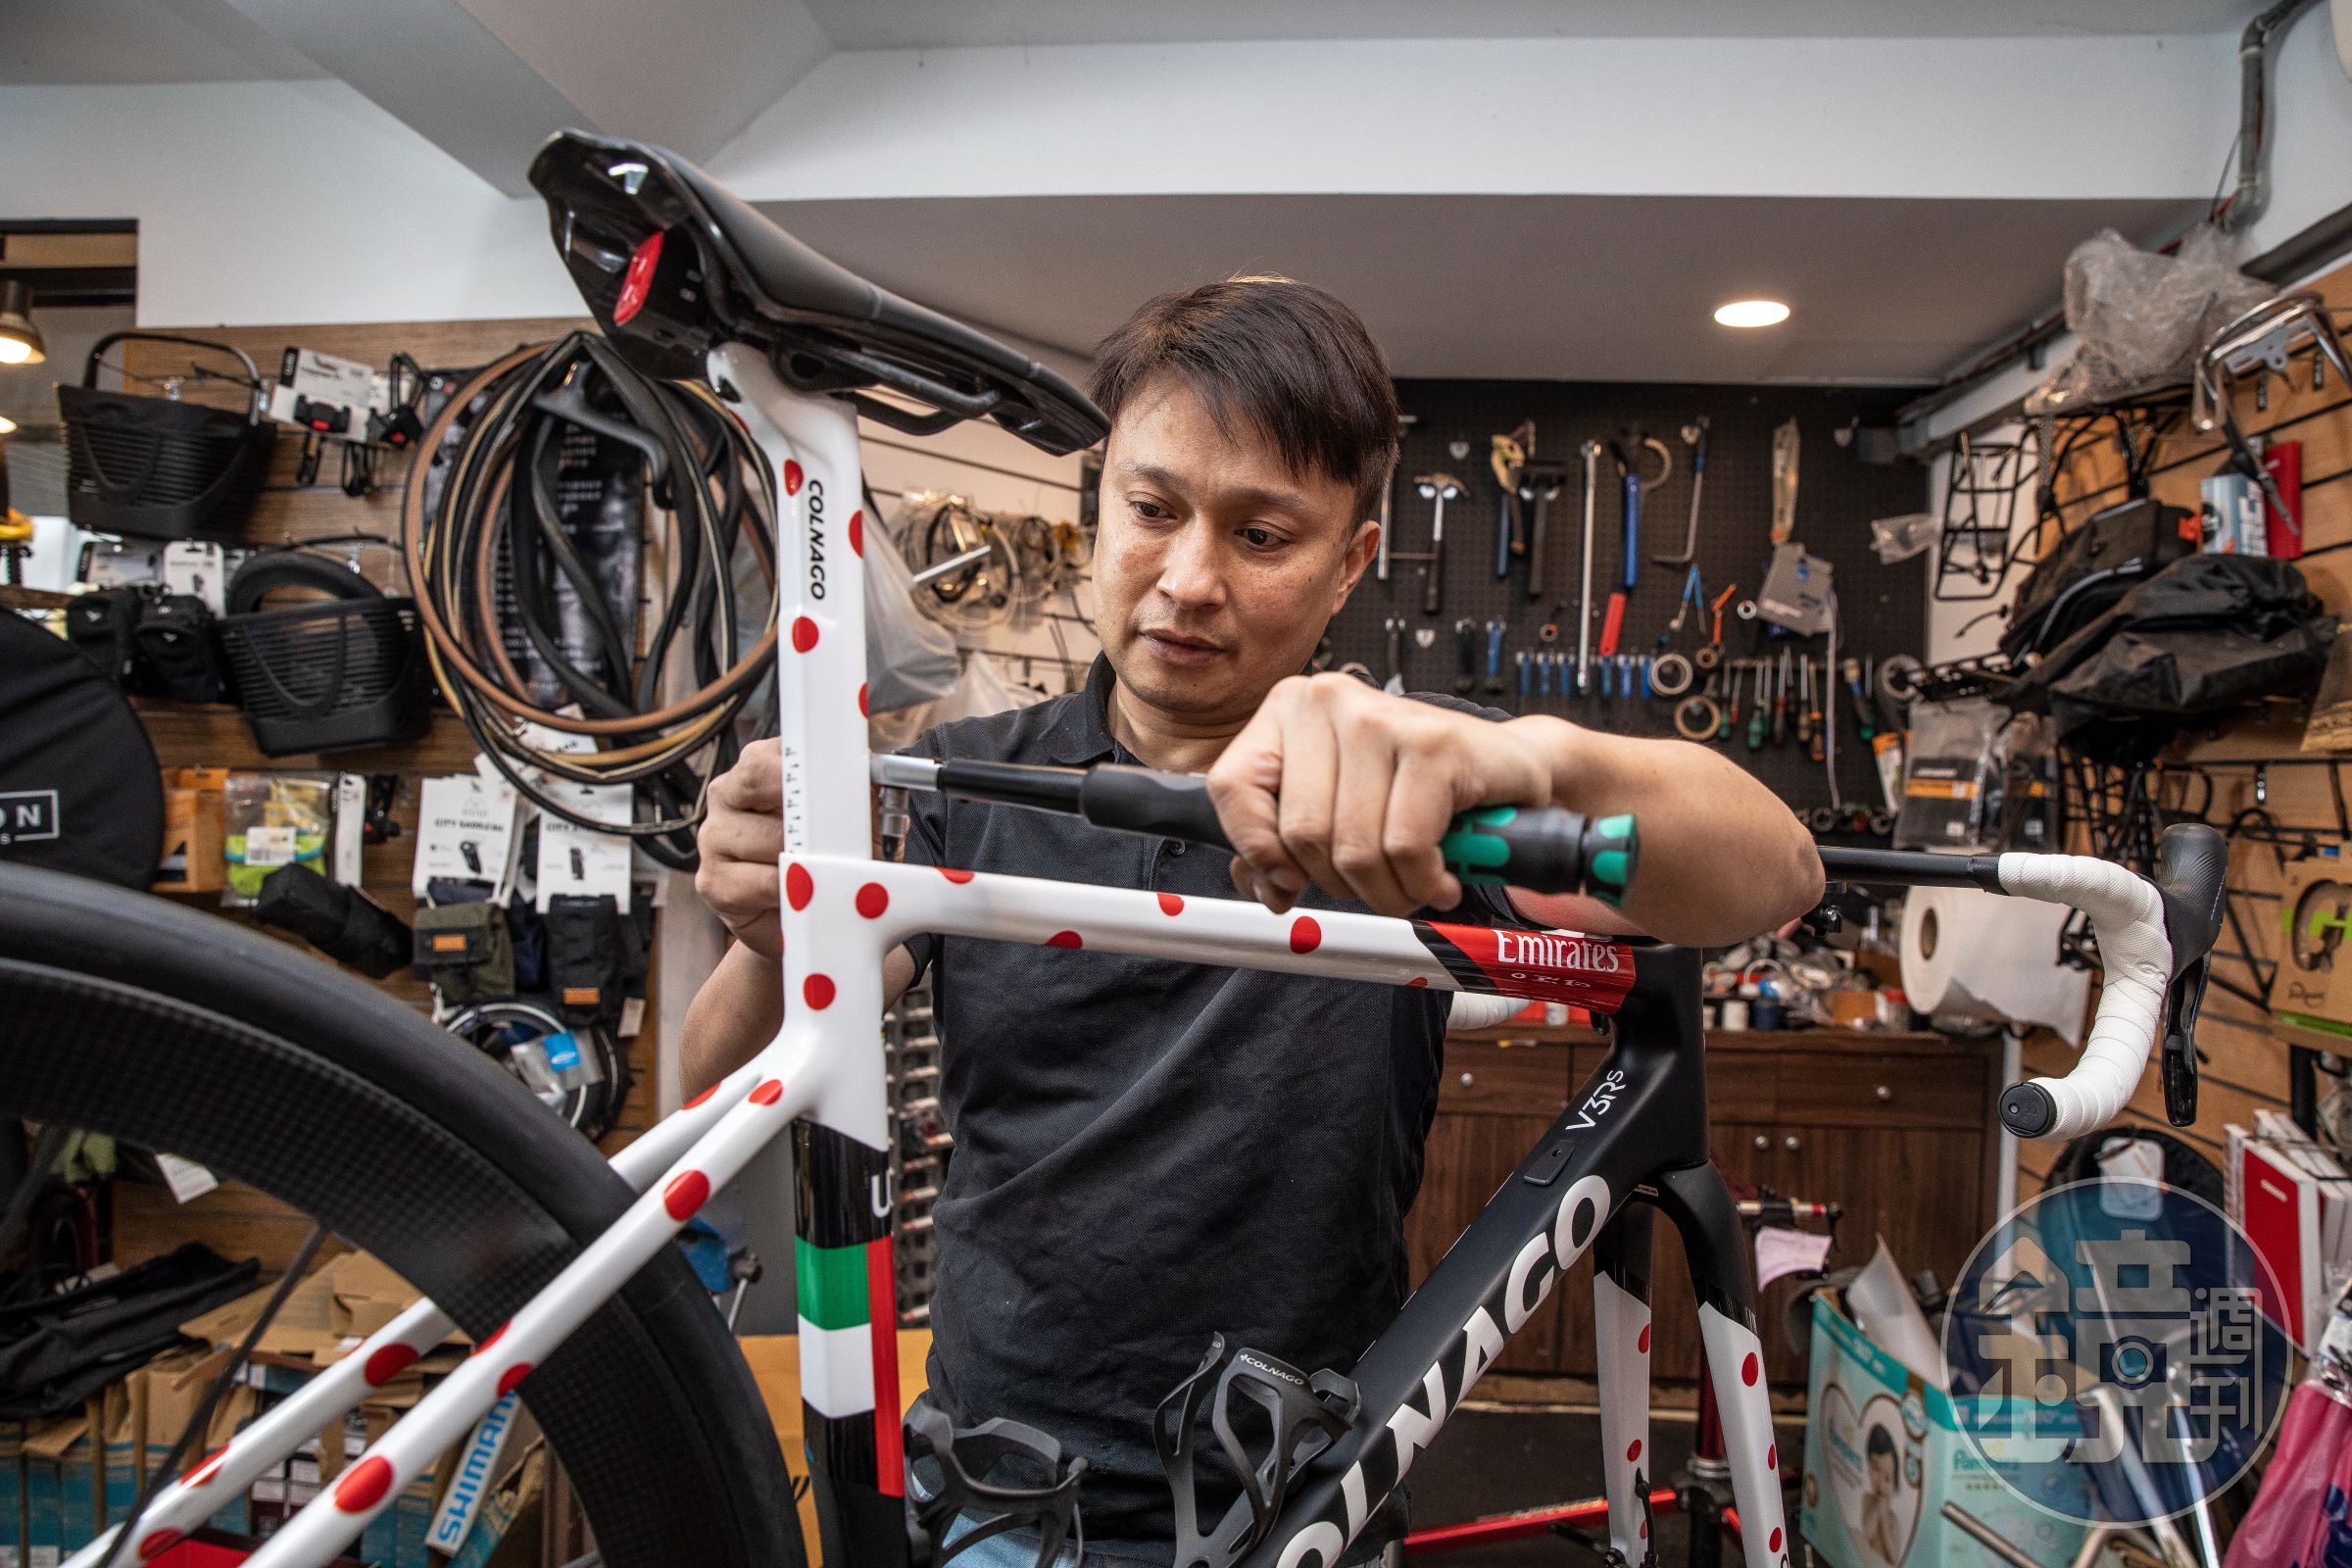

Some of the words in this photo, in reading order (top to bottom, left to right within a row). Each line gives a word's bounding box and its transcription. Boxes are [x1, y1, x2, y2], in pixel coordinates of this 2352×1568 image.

[808, 479, 825, 600] COLNAGO
[1493, 929, 1619, 973] Emirates
[1565, 1070, 1627, 1130] V3RS
[1246, 1357, 1304, 1385] COLNAGO
[438, 1390, 518, 1544] SHIMAN
